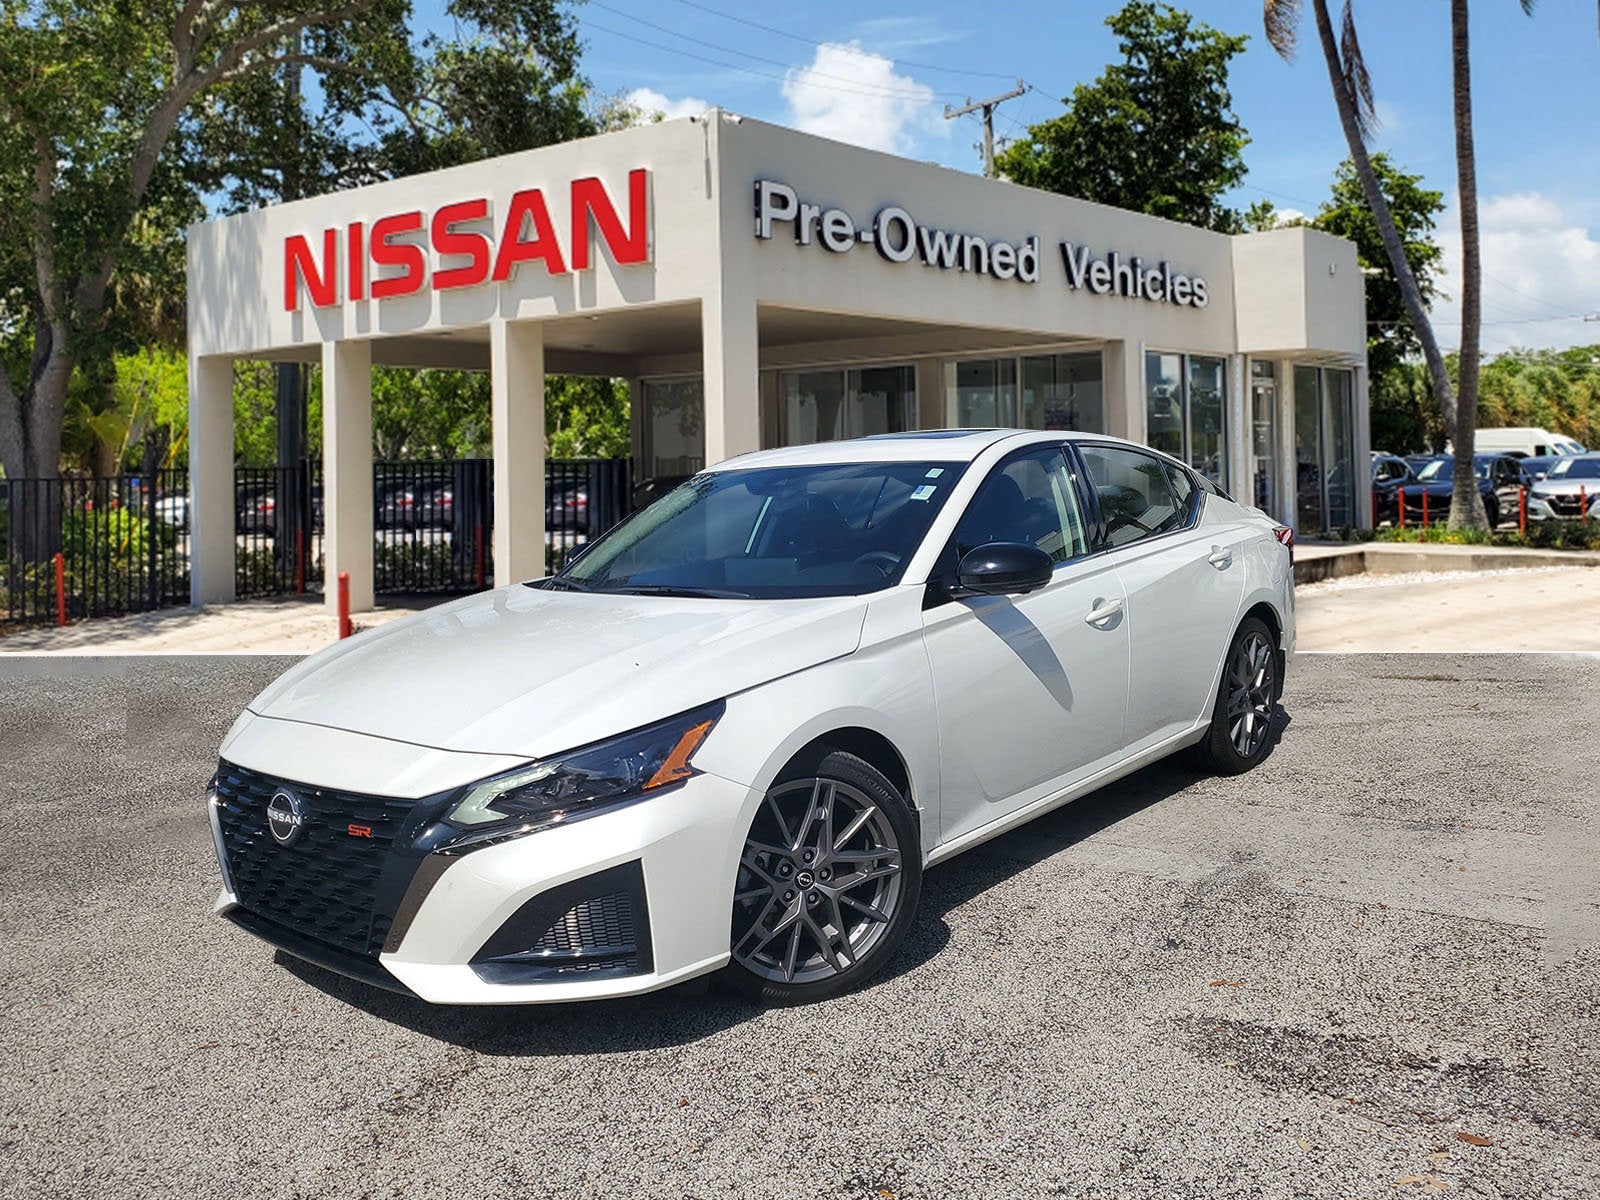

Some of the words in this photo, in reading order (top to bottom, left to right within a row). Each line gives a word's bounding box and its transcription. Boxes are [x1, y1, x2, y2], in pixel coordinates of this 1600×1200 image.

[285, 168, 649, 312] NISSAN
[754, 180, 1039, 283] Pre-Owned
[1060, 242, 1208, 308] Vehicles
[268, 807, 300, 825] SSAN
[347, 823, 372, 838] SR
